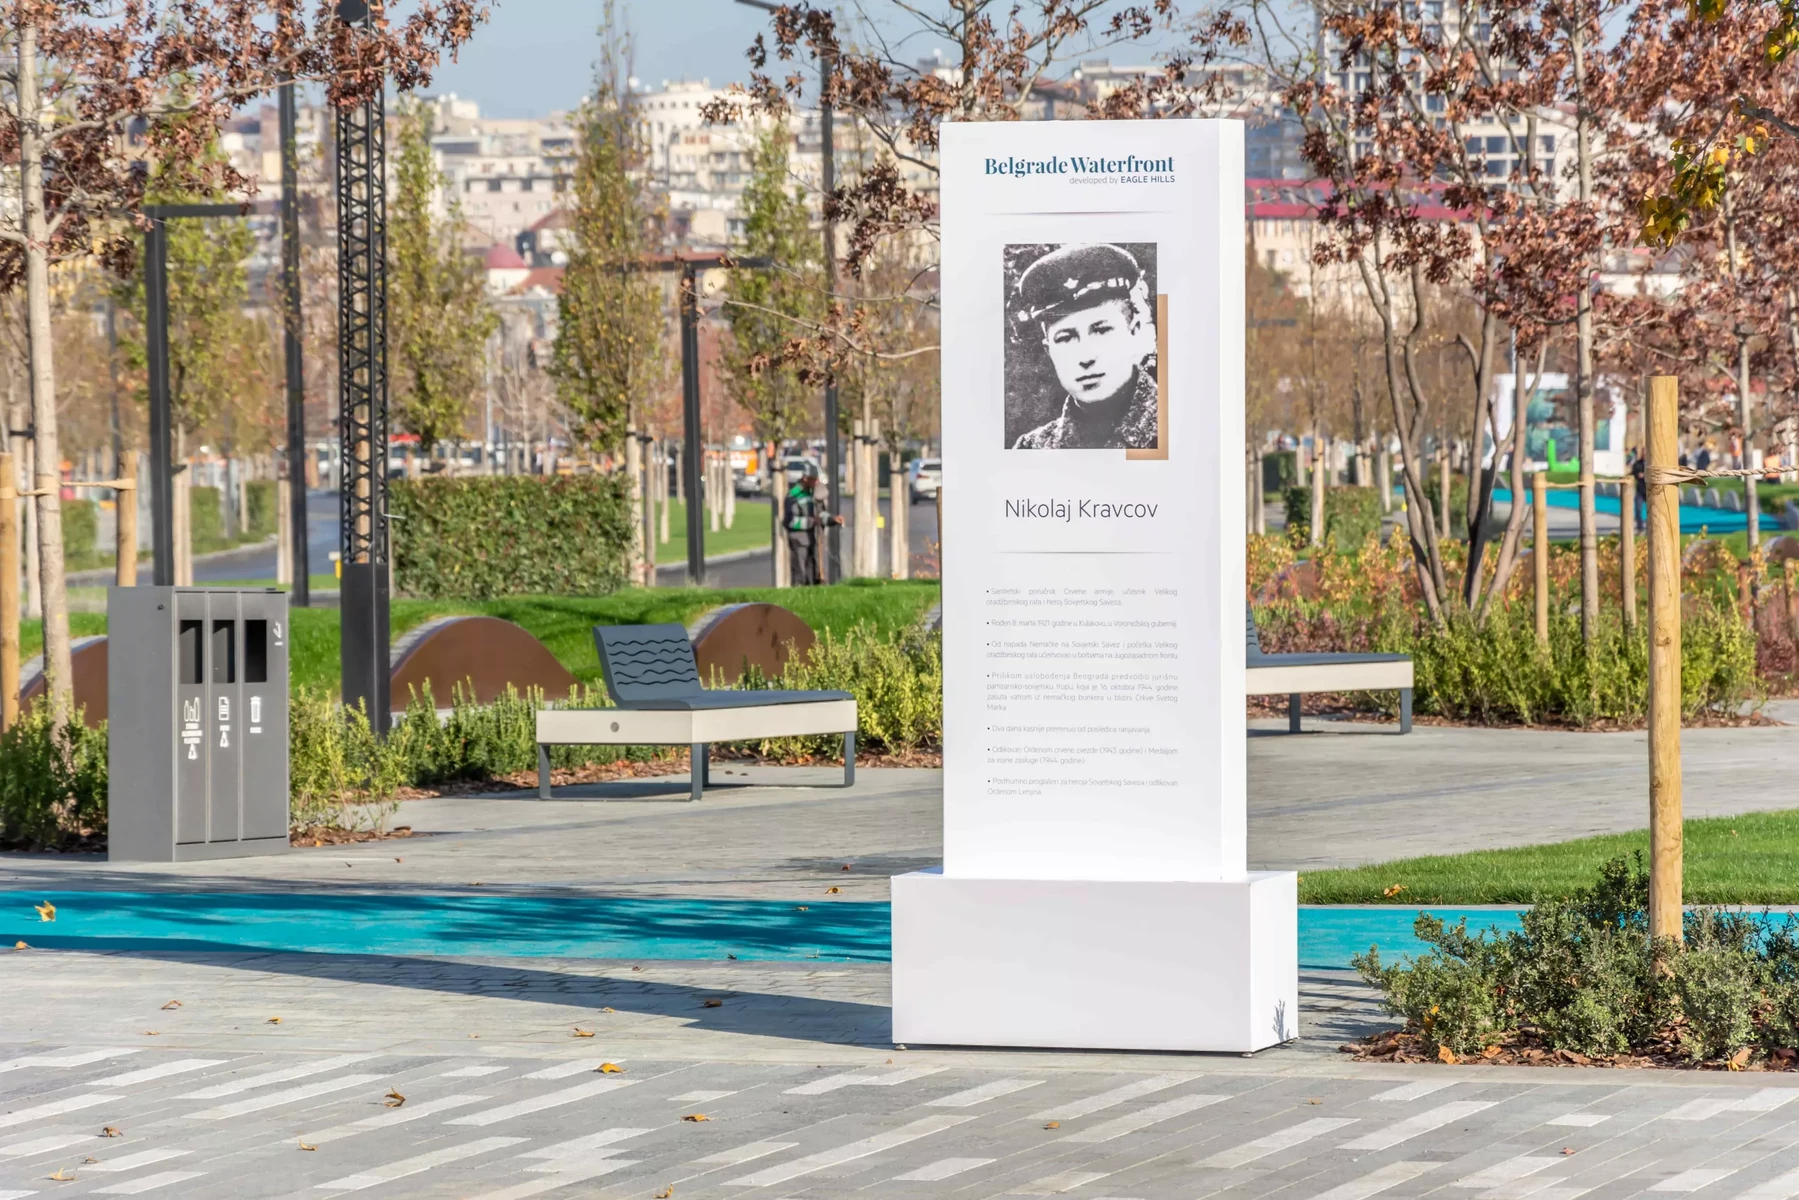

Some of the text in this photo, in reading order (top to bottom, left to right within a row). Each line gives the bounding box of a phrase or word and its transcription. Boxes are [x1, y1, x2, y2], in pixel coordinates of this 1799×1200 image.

[985, 154, 1176, 179] Belgrade Waterfront
[1069, 175, 1176, 186] developed by EAGLE HILLS
[1005, 498, 1159, 523] Nikolaj Kravcov
[1154, 588, 1178, 597] Velikog
[1127, 641, 1152, 649] početka
[1073, 673, 1109, 681] Beograda
[1156, 684, 1178, 692] godine
[1043, 694, 1076, 702] nemačkog
[1156, 695, 1178, 703] Svetog
[1029, 778, 1059, 786] proglašen
